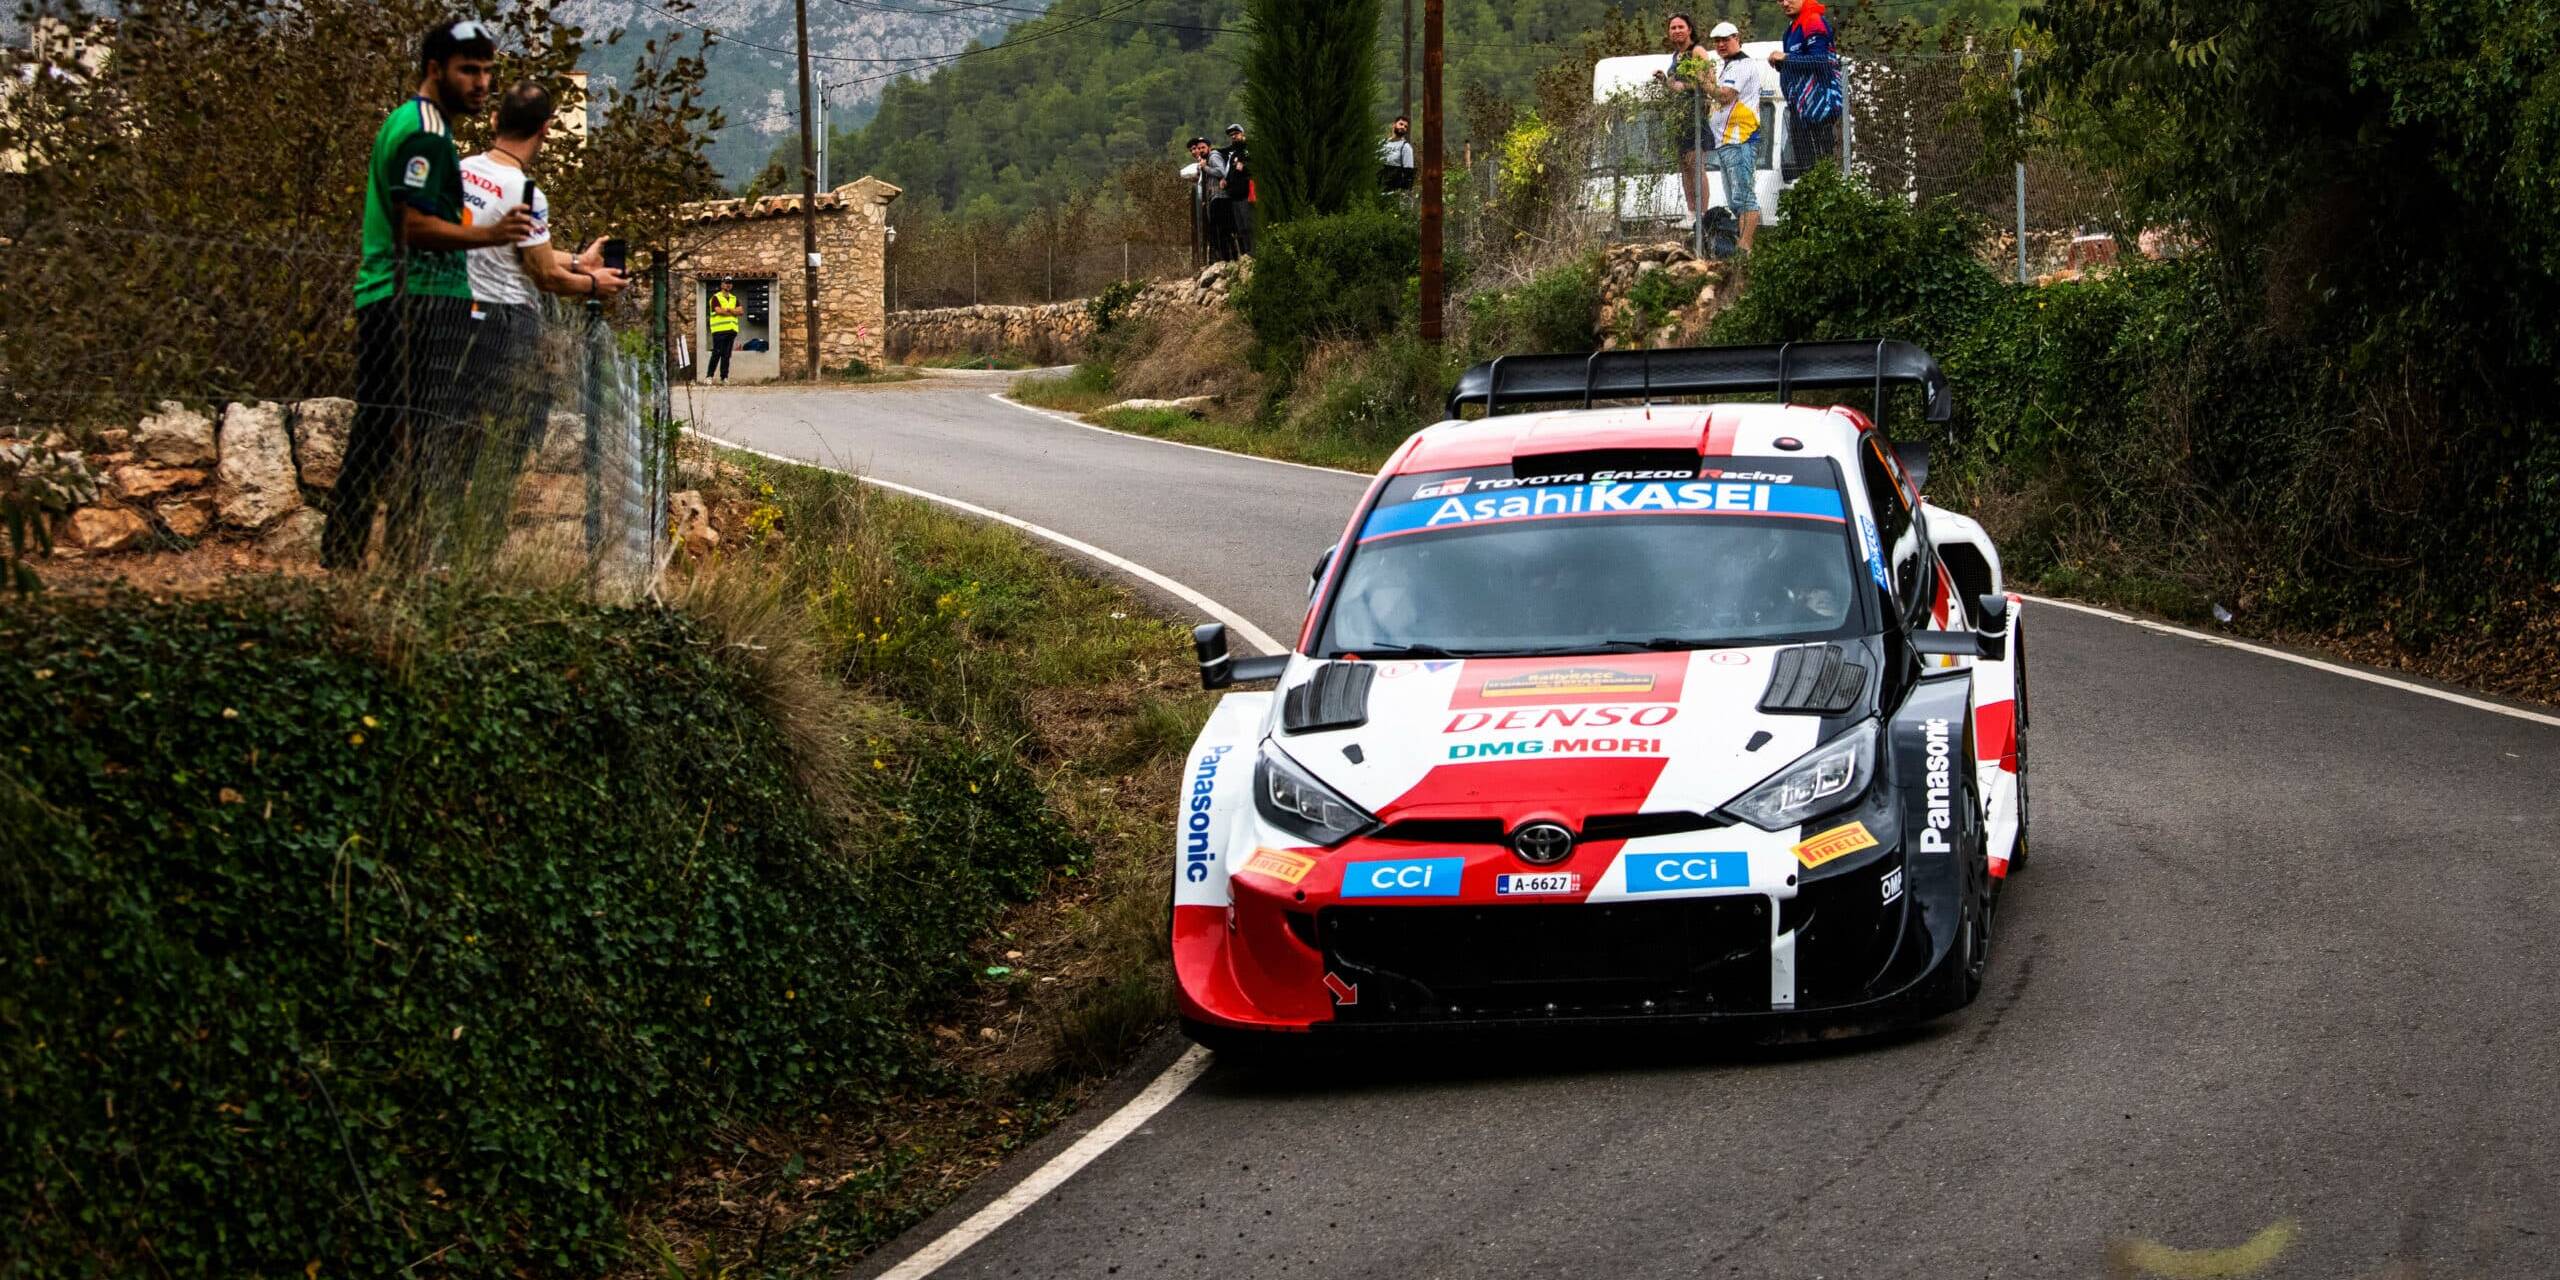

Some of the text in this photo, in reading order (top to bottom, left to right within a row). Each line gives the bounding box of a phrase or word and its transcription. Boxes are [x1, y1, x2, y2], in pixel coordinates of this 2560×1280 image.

[461, 169, 503, 199] ONDA
[1475, 469, 1793, 490] TOYOTA GAZOO Racing
[1442, 706, 1678, 734] DENSO
[1448, 738, 1661, 759] DMG MORI
[1918, 718, 1951, 853] Panasonic
[1187, 745, 1233, 882] Panasonic
[1799, 827, 1868, 862] PIRELLI
[1248, 849, 1306, 878] PIRELLI
[1515, 877, 1567, 891] A-6627
[1881, 871, 1902, 899] OMP
